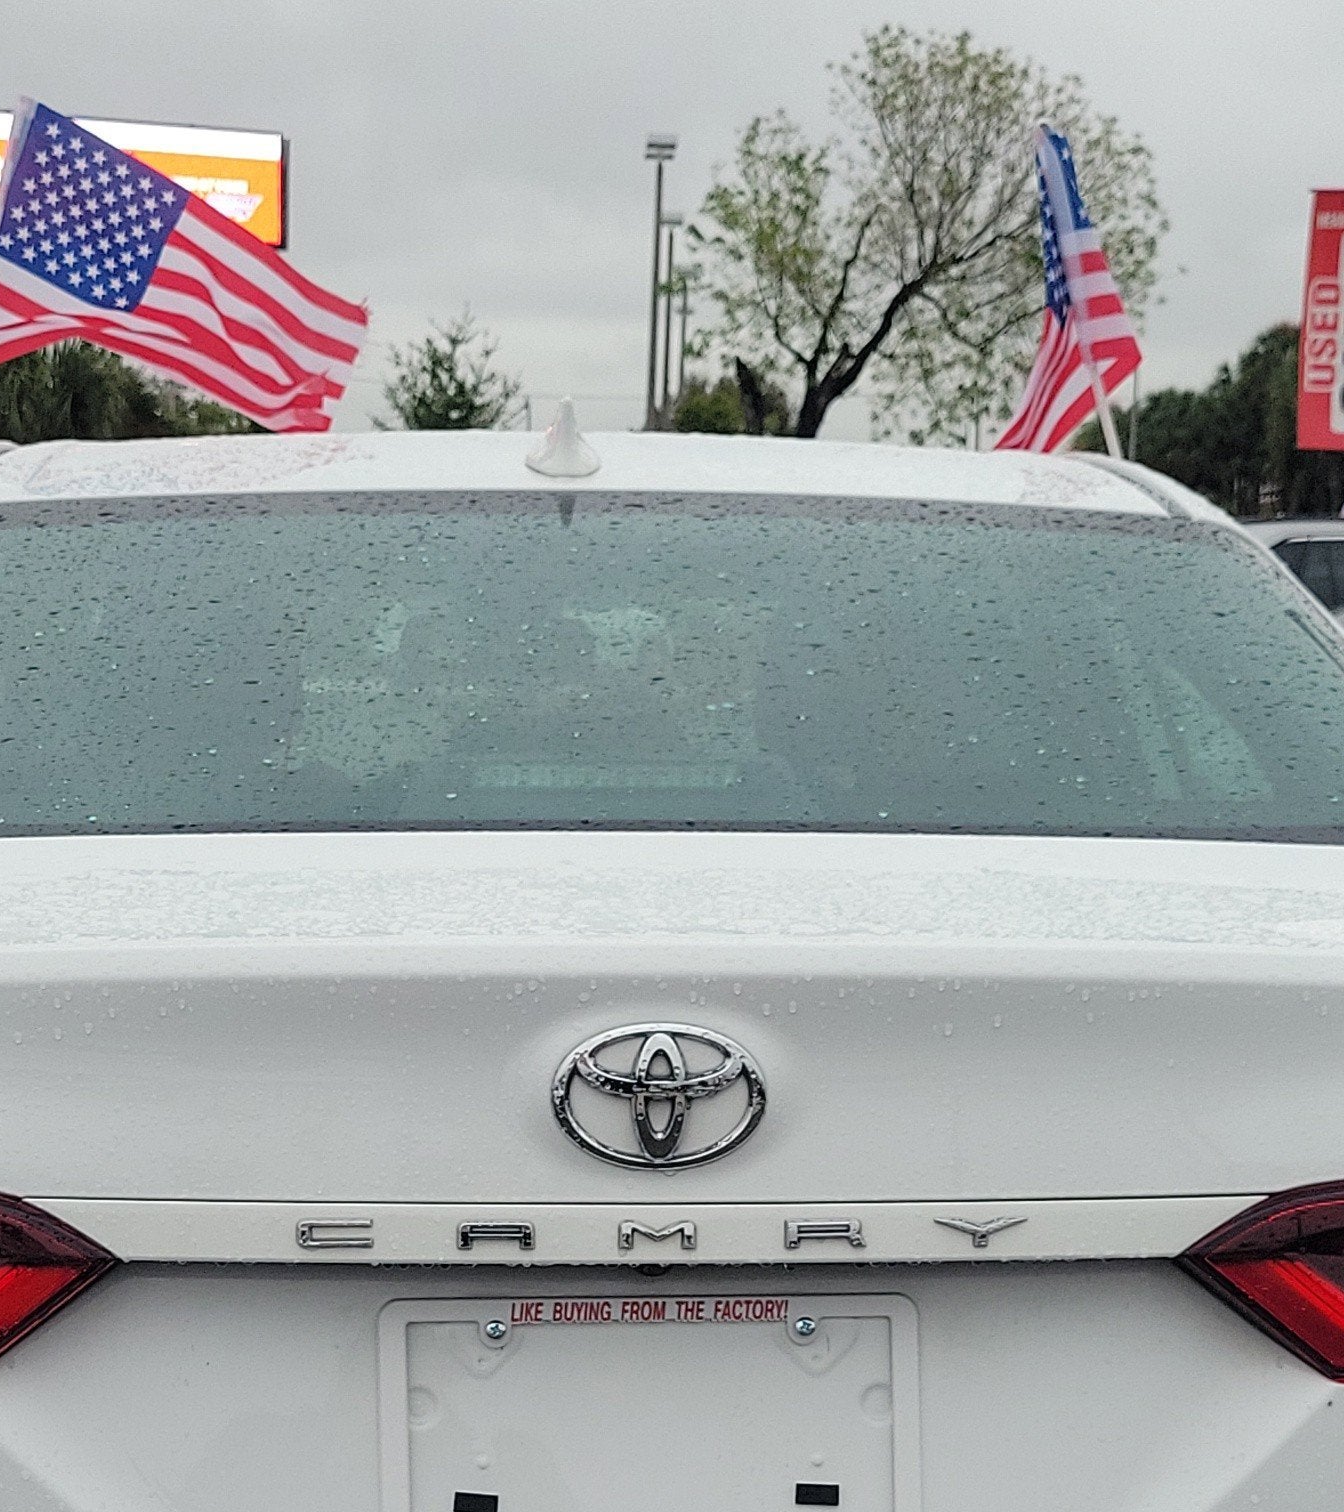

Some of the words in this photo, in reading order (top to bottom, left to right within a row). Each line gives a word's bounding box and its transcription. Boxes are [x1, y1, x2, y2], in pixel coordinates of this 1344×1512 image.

[1309, 283, 1340, 386] USED
[295, 1216, 1029, 1251] CAMRY
[511, 1303, 544, 1322] LIKE
[552, 1302, 612, 1321] BUYING
[620, 1302, 667, 1321] FROM
[674, 1301, 705, 1320] THE
[713, 1299, 789, 1320] FACTORY!
